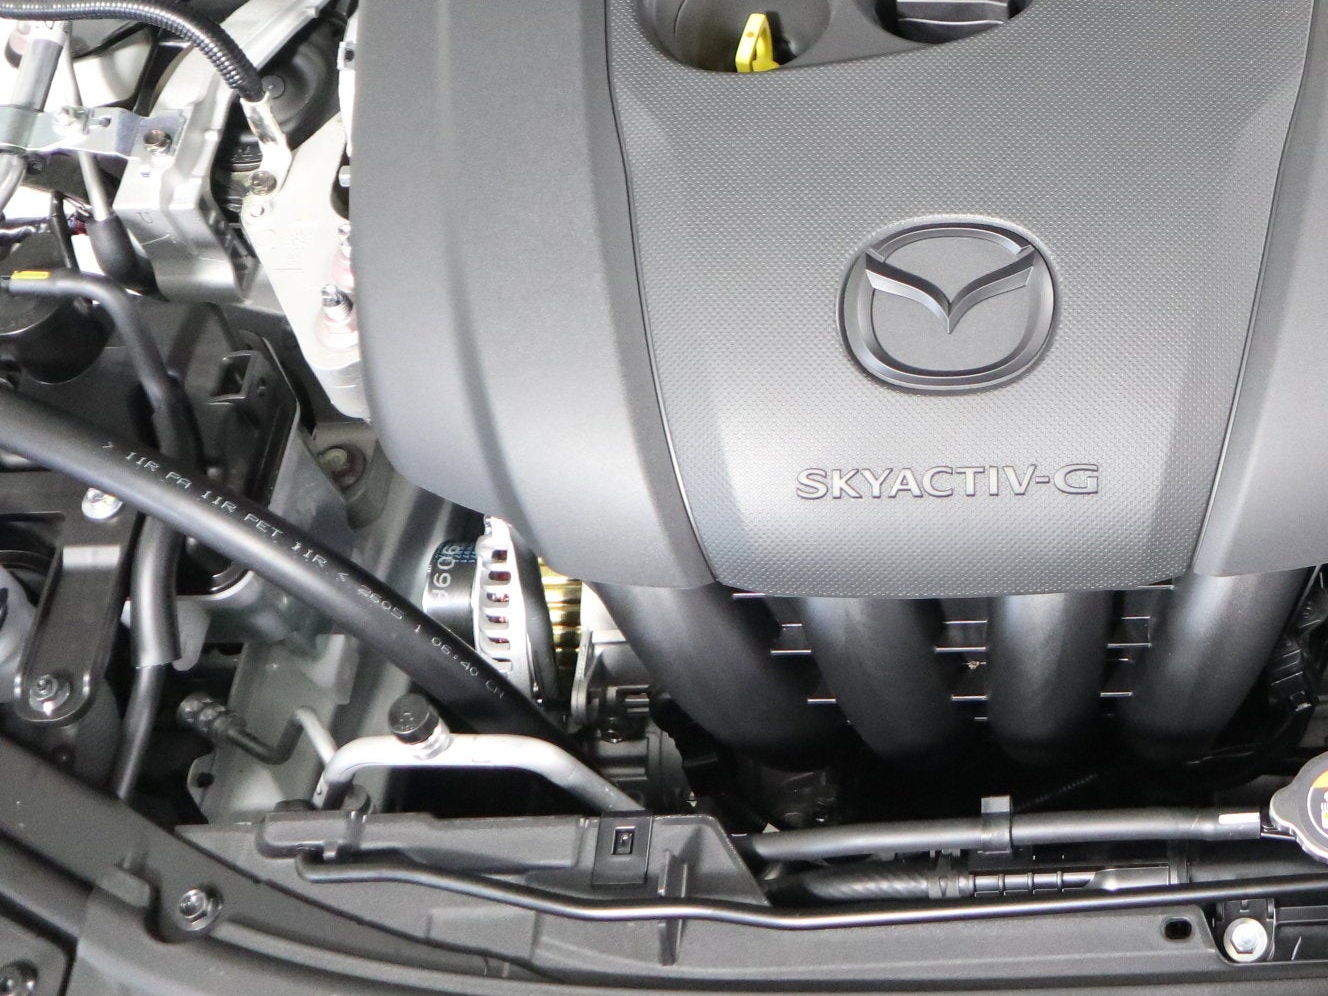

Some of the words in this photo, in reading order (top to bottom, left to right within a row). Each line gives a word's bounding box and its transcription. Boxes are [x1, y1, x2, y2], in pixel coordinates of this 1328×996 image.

[165, 471, 192, 490] PA
[243, 513, 284, 538] PET
[796, 463, 1099, 500] SKYACTIV-G
